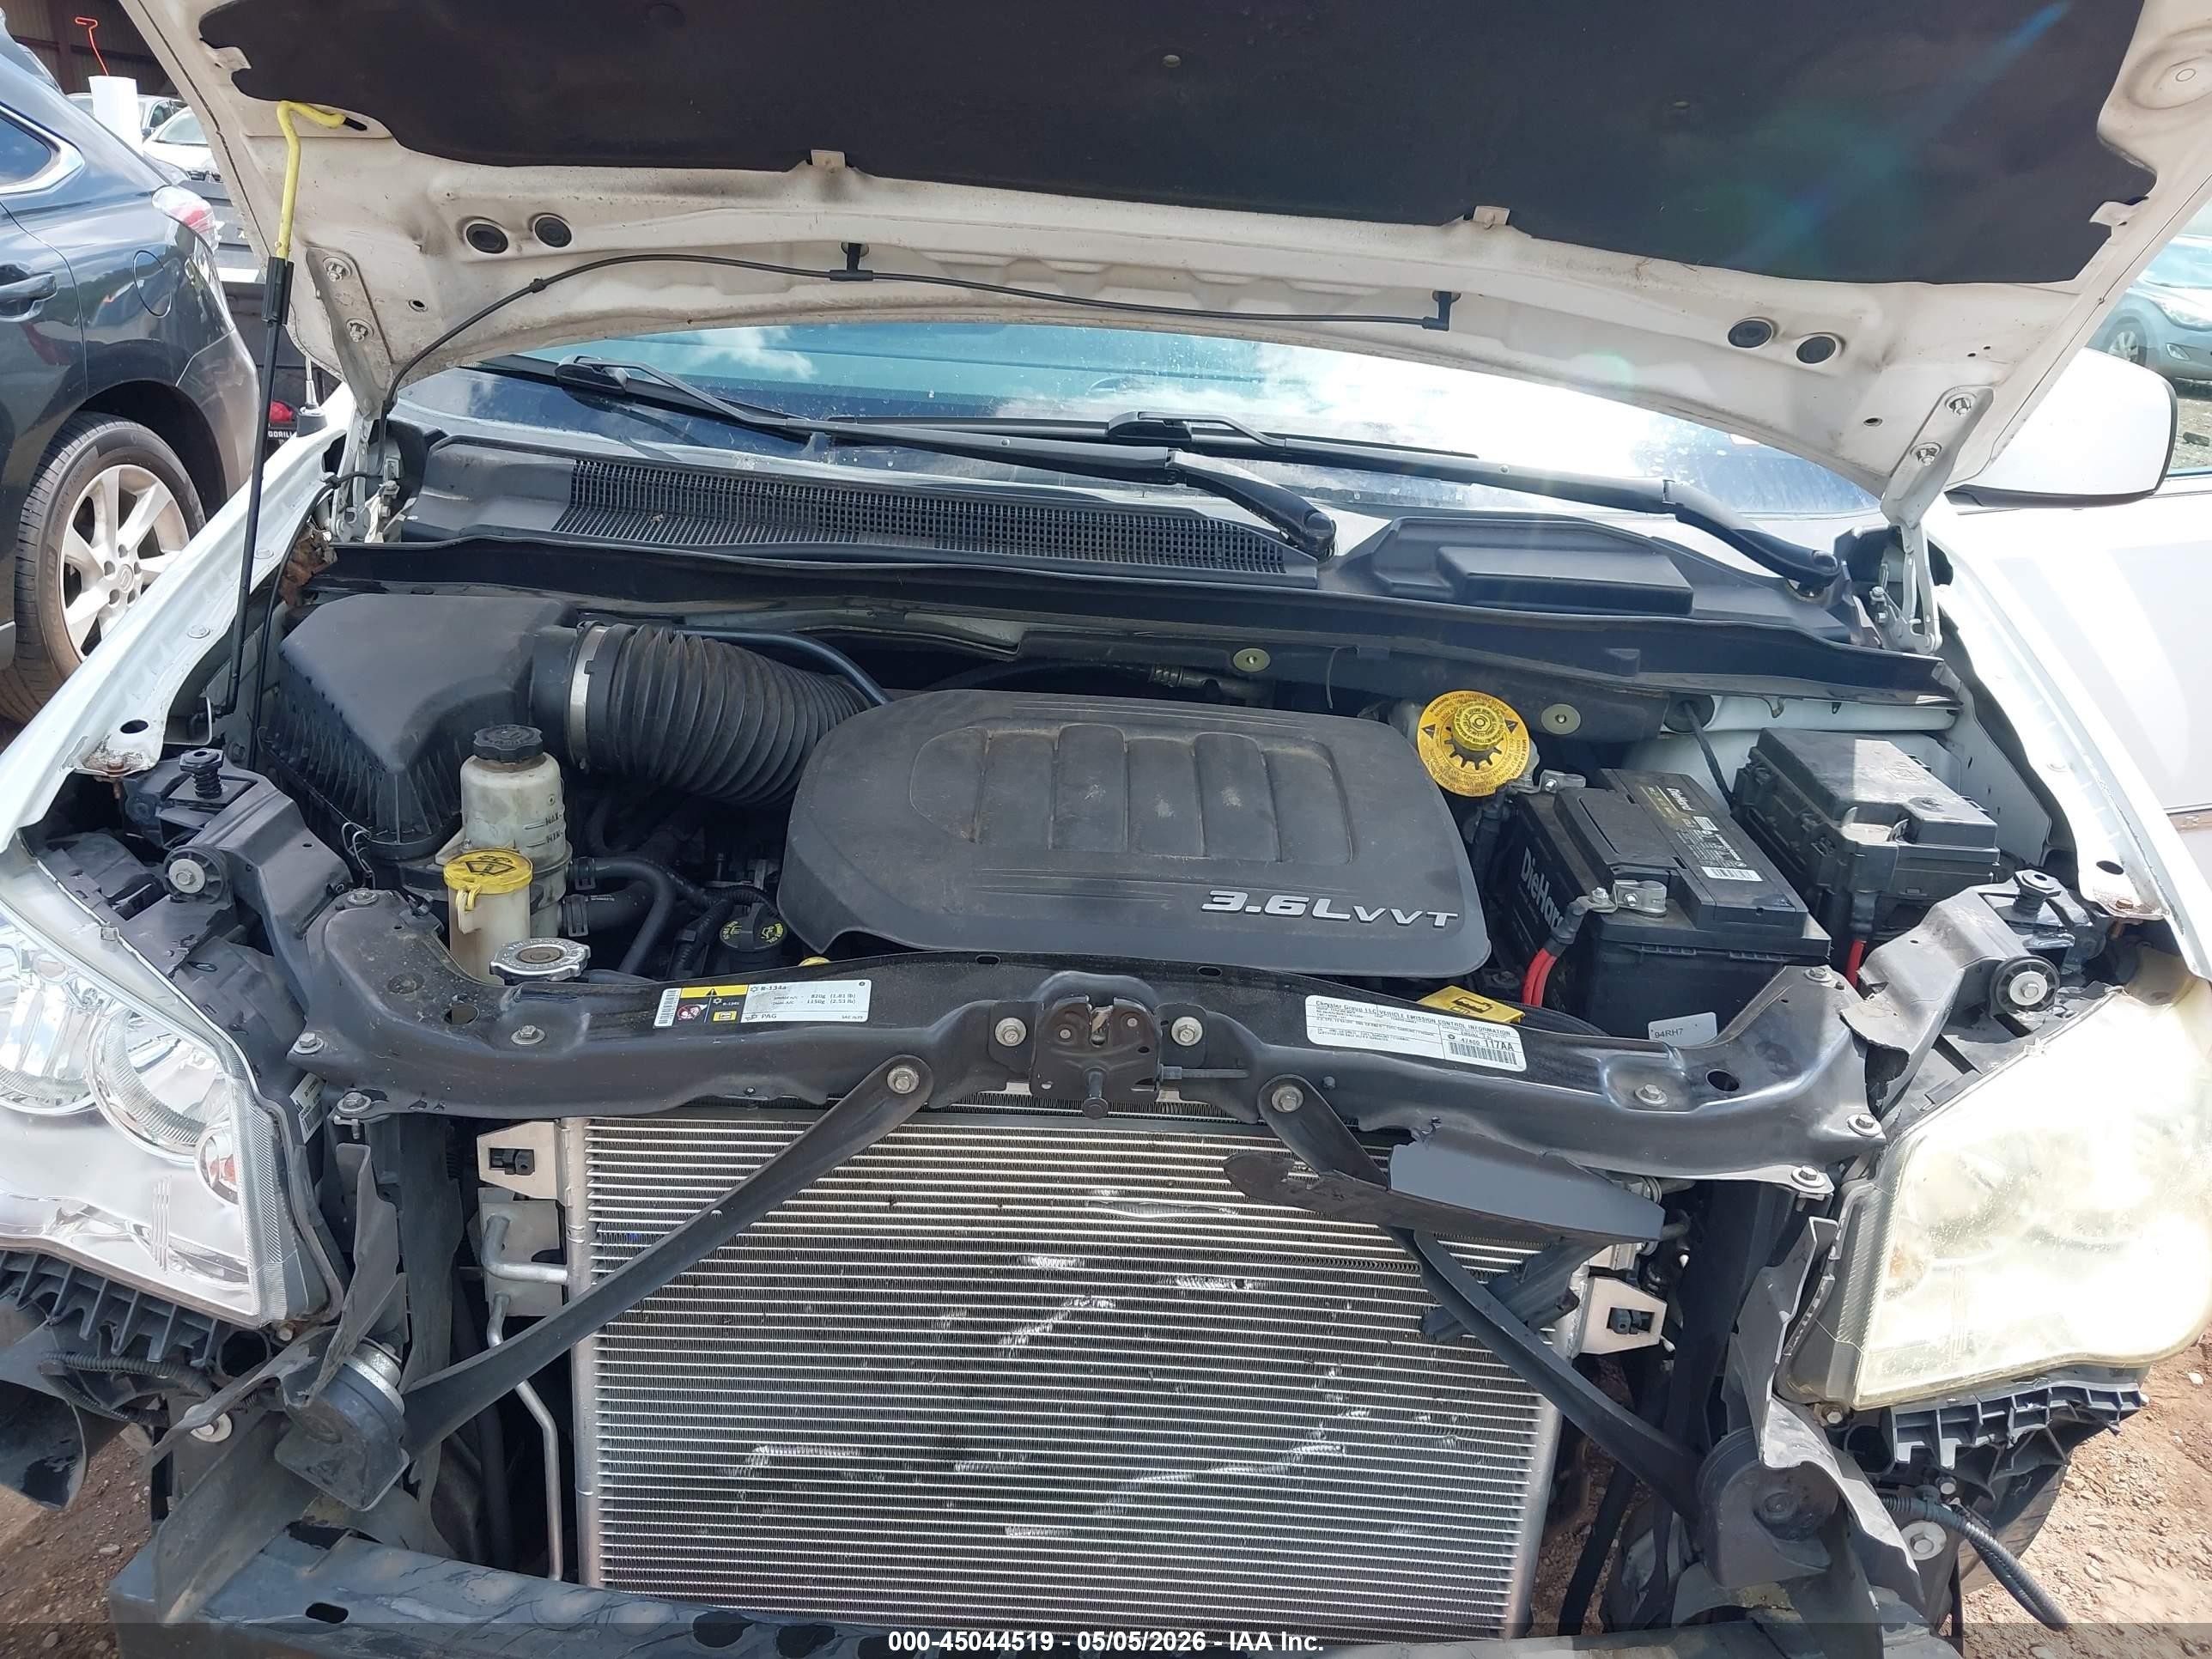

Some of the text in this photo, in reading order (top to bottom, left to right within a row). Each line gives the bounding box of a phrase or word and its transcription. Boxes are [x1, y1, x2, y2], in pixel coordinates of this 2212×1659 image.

[1521, 847, 1564, 928] DieHar
[1202, 890, 1458, 928] 3.6L VVT
[1316, 1000, 1341, 1009] Chrysler
[1343, 1005, 1364, 1013] Group
[1379, 1010, 1405, 1018] VEHICLE
[1407, 1014, 1437, 1024] EMISSION
[1437, 1019, 1466, 1028] CONTROL
[1468, 1024, 1511, 1036] INFORMATION
[1654, 1028, 1684, 1038] 94RH7
